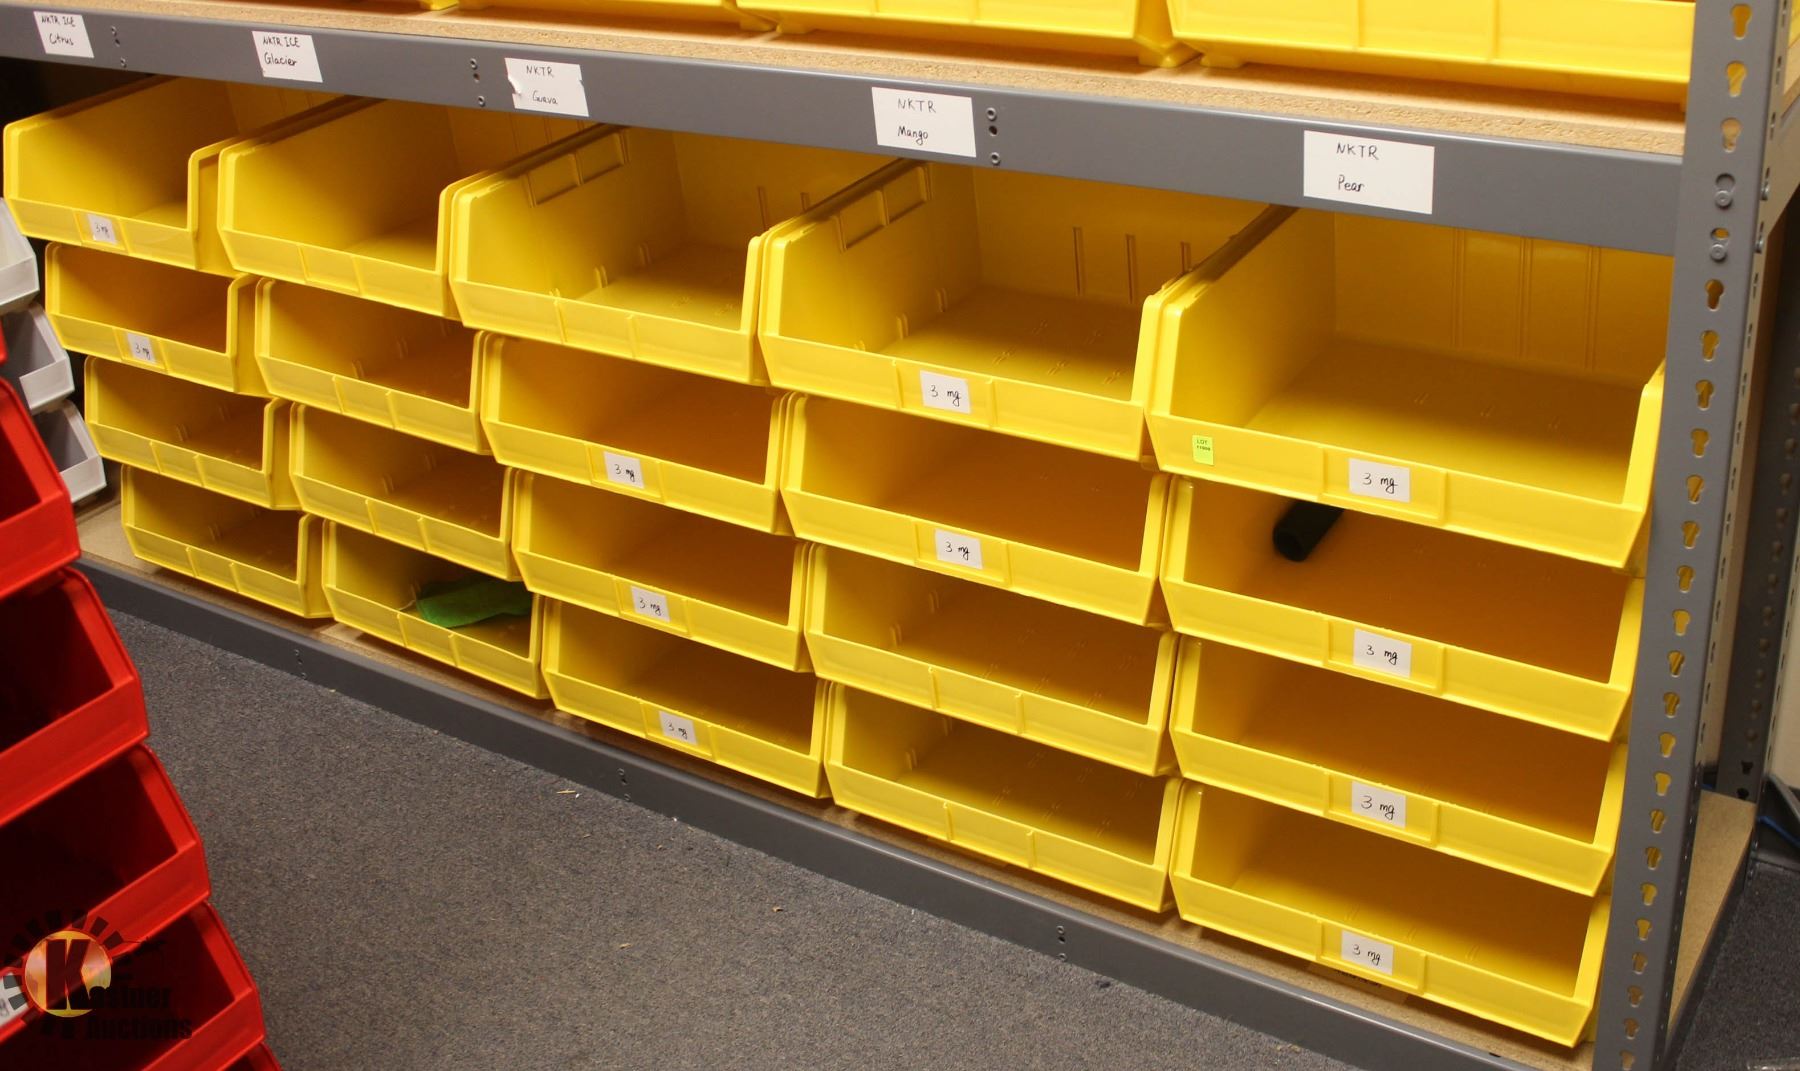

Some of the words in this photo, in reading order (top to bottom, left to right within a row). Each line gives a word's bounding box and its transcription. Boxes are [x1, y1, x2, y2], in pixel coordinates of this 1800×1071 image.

[41, 15, 60, 26] NKTR
[49, 33, 74, 46] Citrus
[262, 36, 281, 47] NKTR
[283, 37, 300, 48] ICE
[264, 52, 297, 66] Glacier
[526, 65, 554, 78] NKTR
[532, 90, 558, 105] Guava
[897, 97, 937, 114] NKTR
[897, 125, 929, 146] Mango
[1336, 142, 1380, 160] NKTR
[1337, 174, 1366, 192] Pear
[931, 385, 938, 398] 3
[947, 391, 961, 408] mg
[614, 463, 621, 475] 3
[1362, 472, 1371, 485] 3
[1380, 477, 1398, 494] mg
[945, 541, 953, 553] 3
[958, 546, 970, 561] mg
[639, 597, 646, 609] 3
[1366, 644, 1375, 656] 3
[1384, 650, 1398, 665] mg
[668, 721, 675, 732] 3
[1361, 795, 1373, 810] 3
[1379, 802, 1395, 821] mg
[1353, 944, 1361, 956] 3
[1367, 951, 1381, 967] mg
